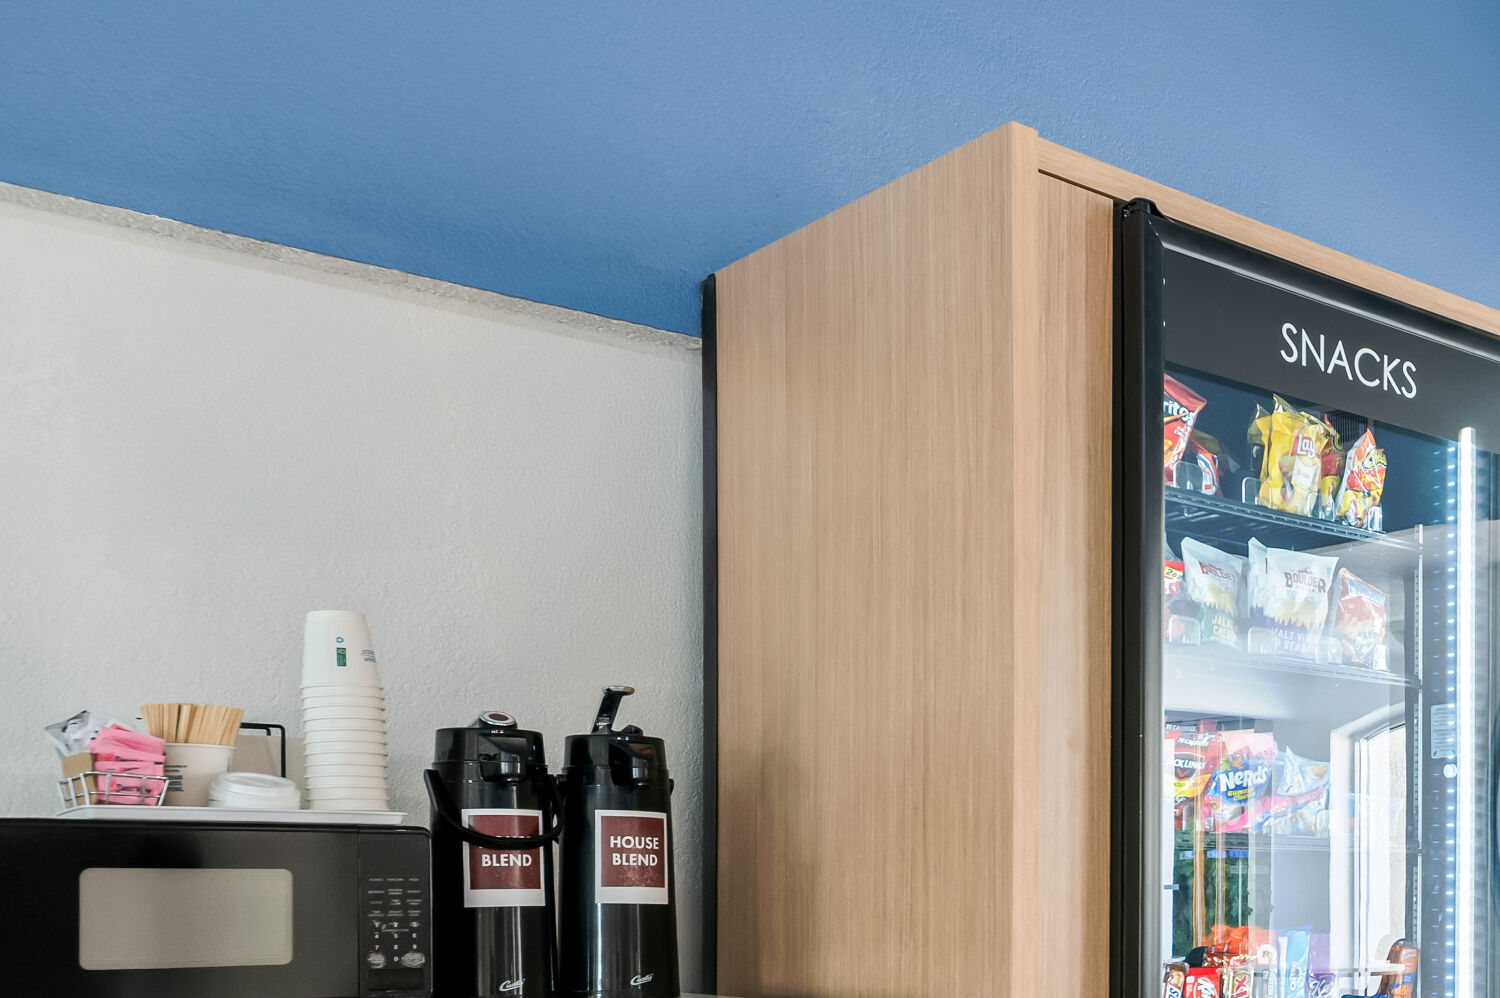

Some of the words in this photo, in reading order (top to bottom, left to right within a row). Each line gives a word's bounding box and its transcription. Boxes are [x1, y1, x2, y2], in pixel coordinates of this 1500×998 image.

[1280, 322, 1417, 399] SNACKS
[1164, 401, 1195, 426] ritos
[1297, 433, 1316, 458] Lay
[1284, 571, 1326, 593] BOULDER
[1219, 766, 1268, 791] Nerds
[610, 836, 659, 850] HOUSE
[481, 854, 532, 867] BLEND
[612, 853, 658, 866] BLEND
